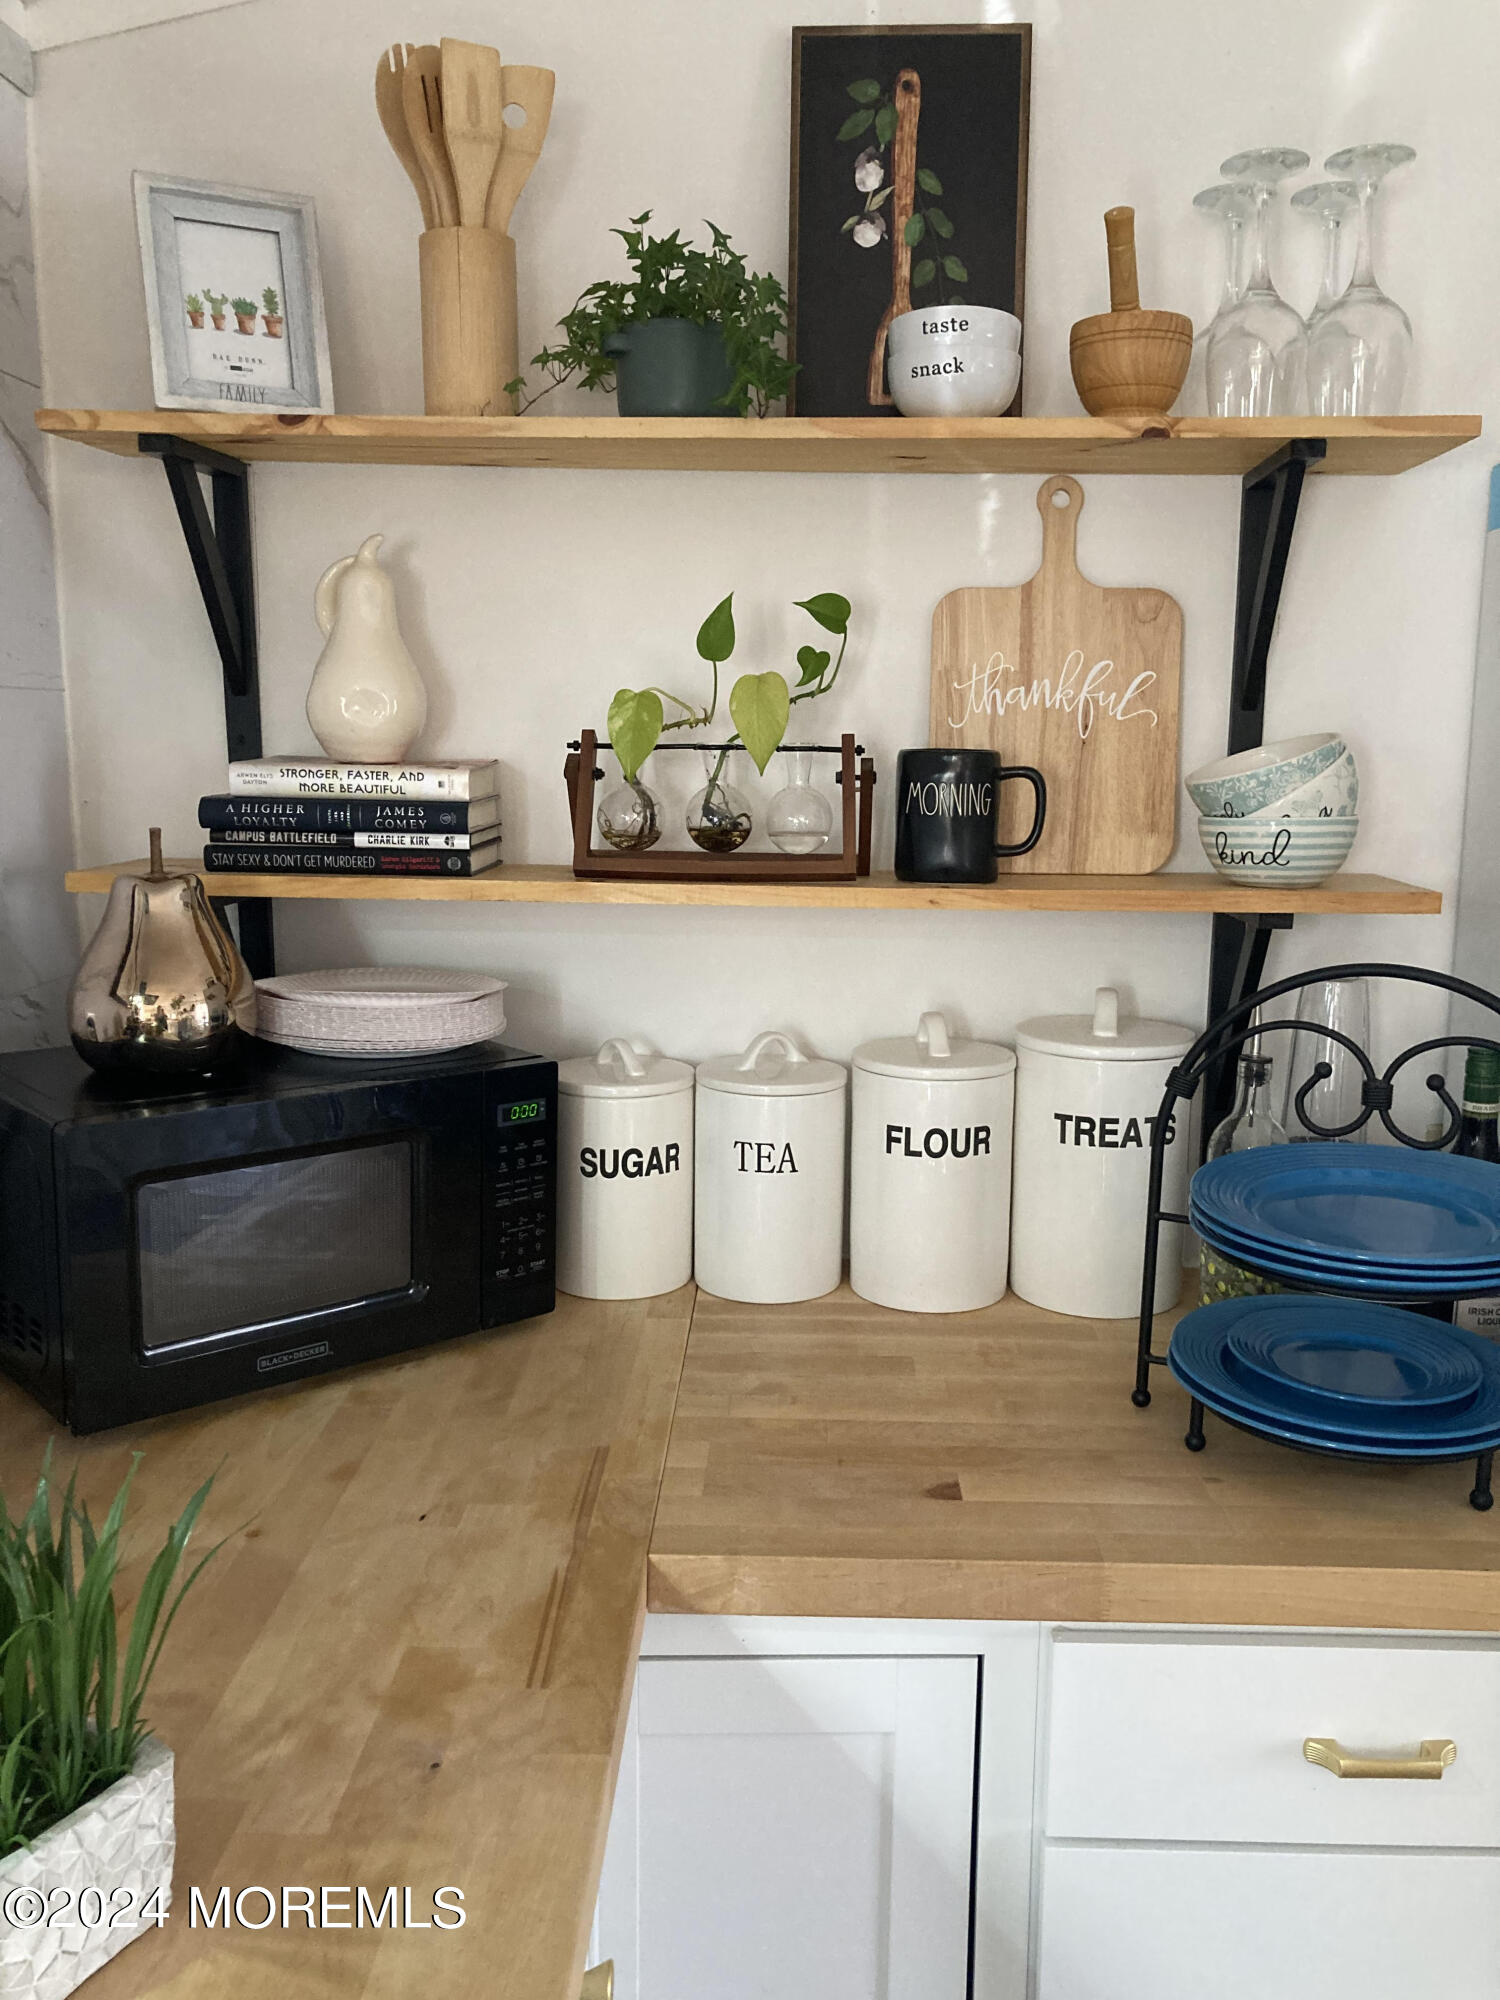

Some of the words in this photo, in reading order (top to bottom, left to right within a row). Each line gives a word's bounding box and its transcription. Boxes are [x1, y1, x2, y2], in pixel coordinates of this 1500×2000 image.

[922, 317, 969, 335] taste
[911, 356, 964, 378] snack
[219, 383, 265, 404] FAMILY
[948, 650, 1158, 739] thankful
[280, 768, 343, 781] STRONGER,
[347, 771, 393, 783] FASTER,
[300, 782, 335, 793] MORE
[339, 783, 406, 795] BEAUTIFUL
[905, 781, 992, 817] MORNING
[225, 804, 235, 813] A
[241, 803, 305, 814] HIGHER
[376, 806, 425, 817] JAMES
[233, 816, 297, 827] LOYALTY
[374, 818, 427, 829] COMEY
[225, 830, 265, 842] CAMPUS
[269, 832, 337, 844] BATTLEFIELD
[367, 834, 406, 845] CHARLIE
[410, 836, 430, 846] KIRK
[1215, 828, 1291, 866] kind
[211, 853, 235, 866] STAY
[237, 853, 261, 866] SEXY
[263, 854, 271, 867] &
[273, 855, 302, 867] DON'T
[304, 855, 322, 867] GET
[324, 855, 376, 868] MURDERED
[886, 1124, 991, 1159] FLOUR
[579, 1142, 680, 1178] SUGAR
[733, 1140, 798, 1173] TEA
[1468, 1307, 1494, 1316] IRISH
